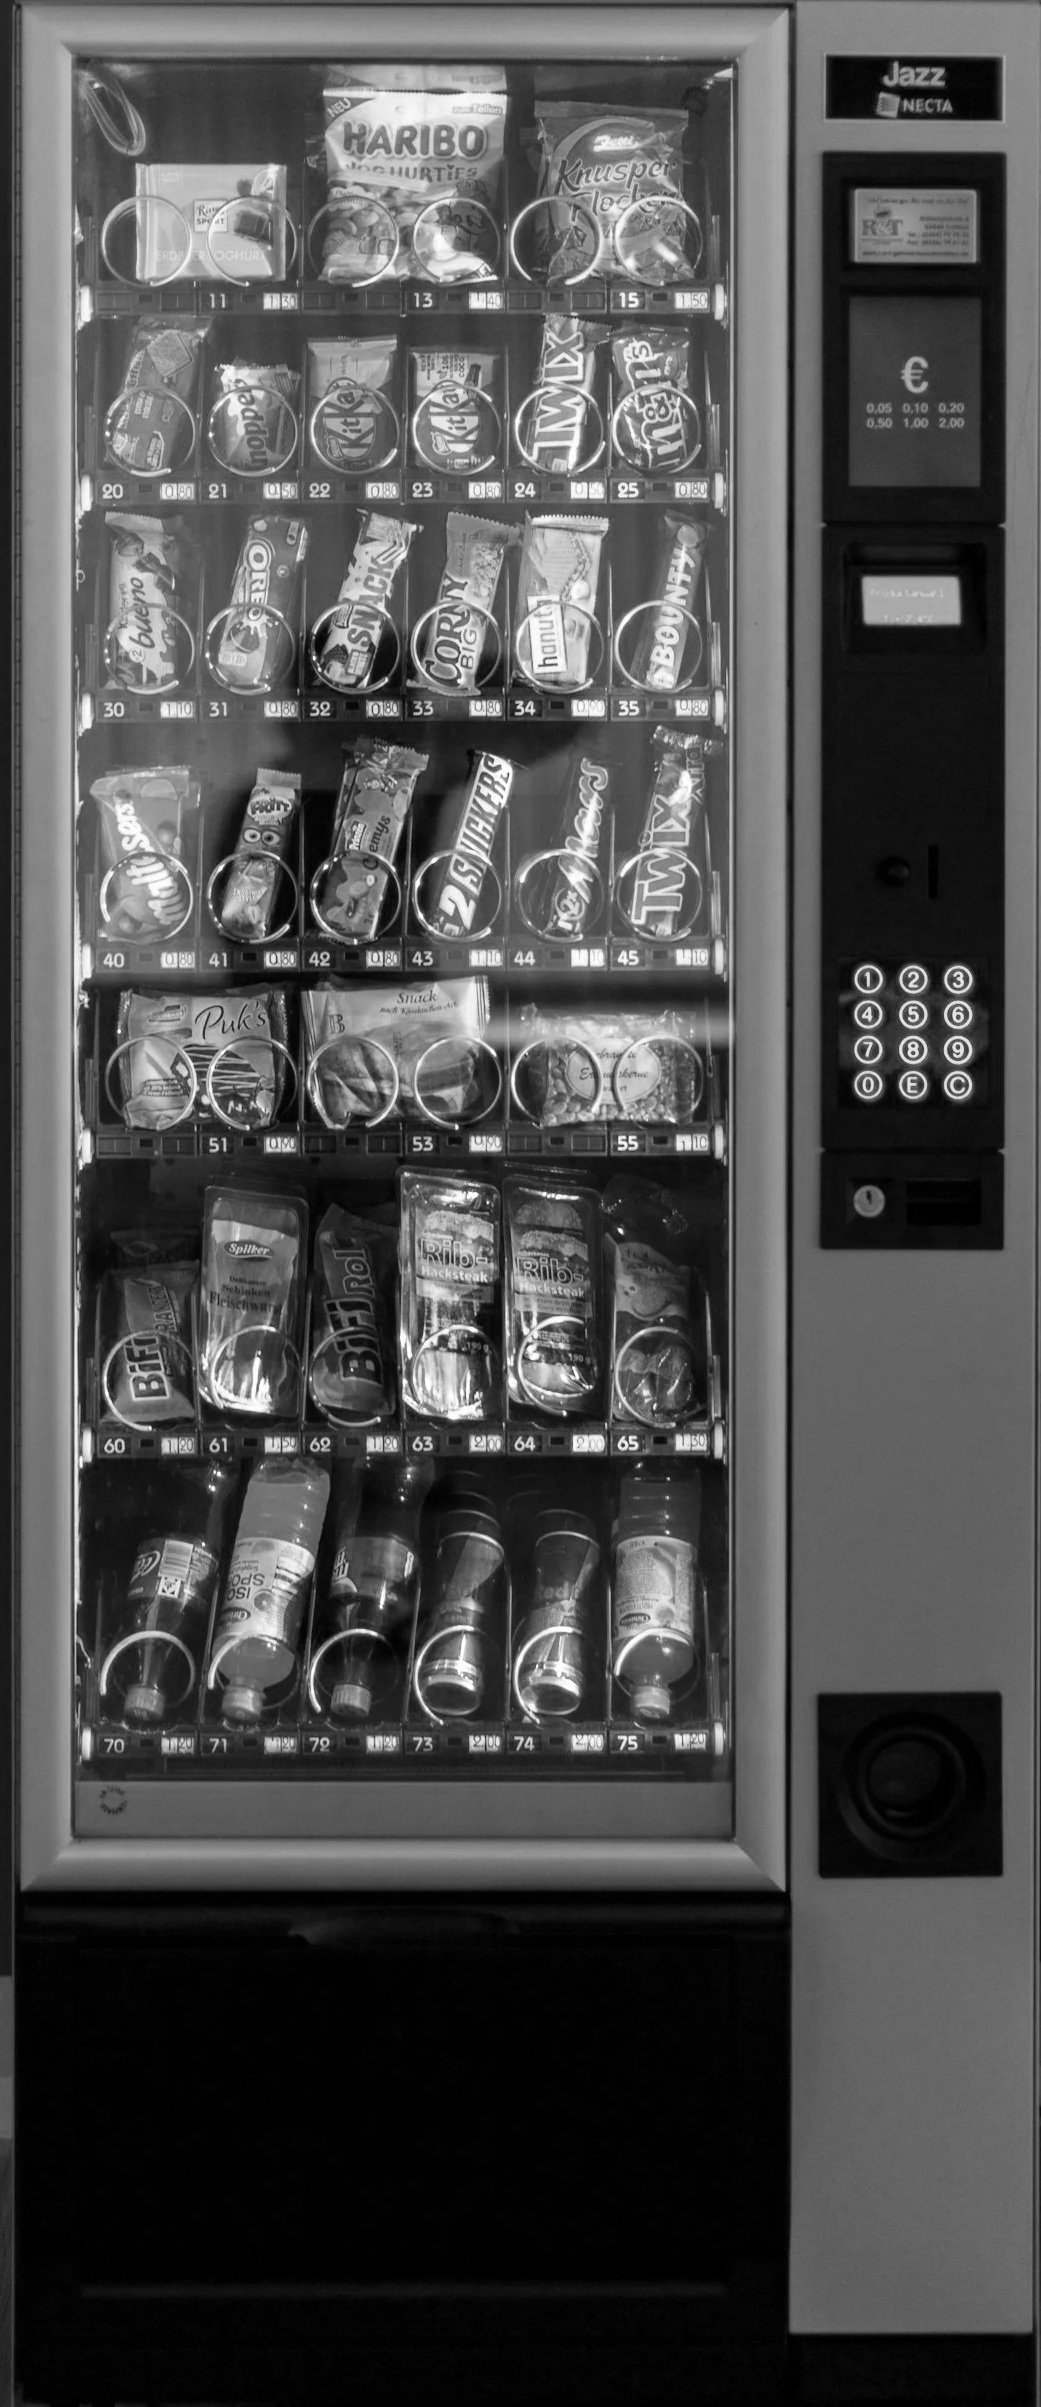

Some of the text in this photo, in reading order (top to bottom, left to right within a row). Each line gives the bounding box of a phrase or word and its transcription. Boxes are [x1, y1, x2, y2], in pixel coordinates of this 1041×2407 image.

[883, 61, 946, 87] Jazz
[326, 97, 352, 119] NEU
[903, 98, 953, 113] NECTA
[343, 120, 485, 158] HARIBO
[554, 158, 672, 196] Knusper
[209, 293, 226, 309] 11
[414, 292, 433, 308] 13
[619, 291, 640, 308] 15
[900, 355, 930, 394] €
[531, 326, 586, 463] TWIX
[866, 402, 965, 415] 0,05 0,10 0,20
[866, 417, 965, 430] 0,50 1,00 2,00
[102, 483, 124, 500] 20
[208, 483, 227, 499] 21
[309, 482, 331, 499] 22
[412, 482, 434, 498] 23
[514, 482, 536, 498] 24
[617, 482, 639, 499] 25
[246, 543, 270, 621] OREO
[347, 556, 394, 648] SNACK
[651, 546, 697, 668] BOUNTY
[128, 576, 156, 650] bueno
[426, 576, 470, 687] CORNY
[536, 597, 560, 668] hanuta
[460, 626, 478, 670] BIG
[103, 702, 125, 718] 30
[209, 701, 228, 718] 31
[309, 701, 331, 717] 32
[413, 700, 434, 716] 33
[514, 700, 536, 716] 34
[618, 700, 640, 717] 35
[361, 815, 391, 871] Cemys
[631, 794, 692, 925] TWIX
[103, 952, 125, 968] 40
[208, 952, 228, 968] 41
[308, 951, 331, 967] 42
[412, 950, 434, 967] 43
[513, 950, 536, 966] 44
[617, 949, 640, 966] 45
[864, 970, 966, 989] 1 2 3
[396, 989, 437, 1004] Snack
[194, 1002, 267, 1041] Puk's
[861, 1006, 965, 1023] 4 5 6
[863, 1041, 965, 1059] 7 8 9
[862, 1076, 966, 1095] 0 E C
[209, 1137, 227, 1153] 51
[412, 1136, 434, 1152] 53
[617, 1135, 639, 1151] 55
[228, 1242, 271, 1255] Spilker
[419, 1238, 489, 1269] Rib-
[421, 1265, 489, 1284] Hacksteak
[516, 1256, 584, 1285] Rib-
[518, 1281, 585, 1298] Hacksteak
[323, 1298, 383, 1387] BiFi
[124, 1335, 170, 1401] BiFi
[103, 1438, 126, 1454] 60
[208, 1437, 228, 1453] 61
[309, 1436, 331, 1453] 62
[411, 1436, 434, 1452] 63
[514, 1435, 536, 1452] 64
[617, 1435, 639, 1452] 65
[103, 1738, 125, 1753] 70
[209, 1737, 228, 1753] 71
[309, 1736, 331, 1752] 72
[412, 1736, 433, 1751] 73
[513, 1735, 535, 1751] 74
[617, 1735, 639, 1751] 75
